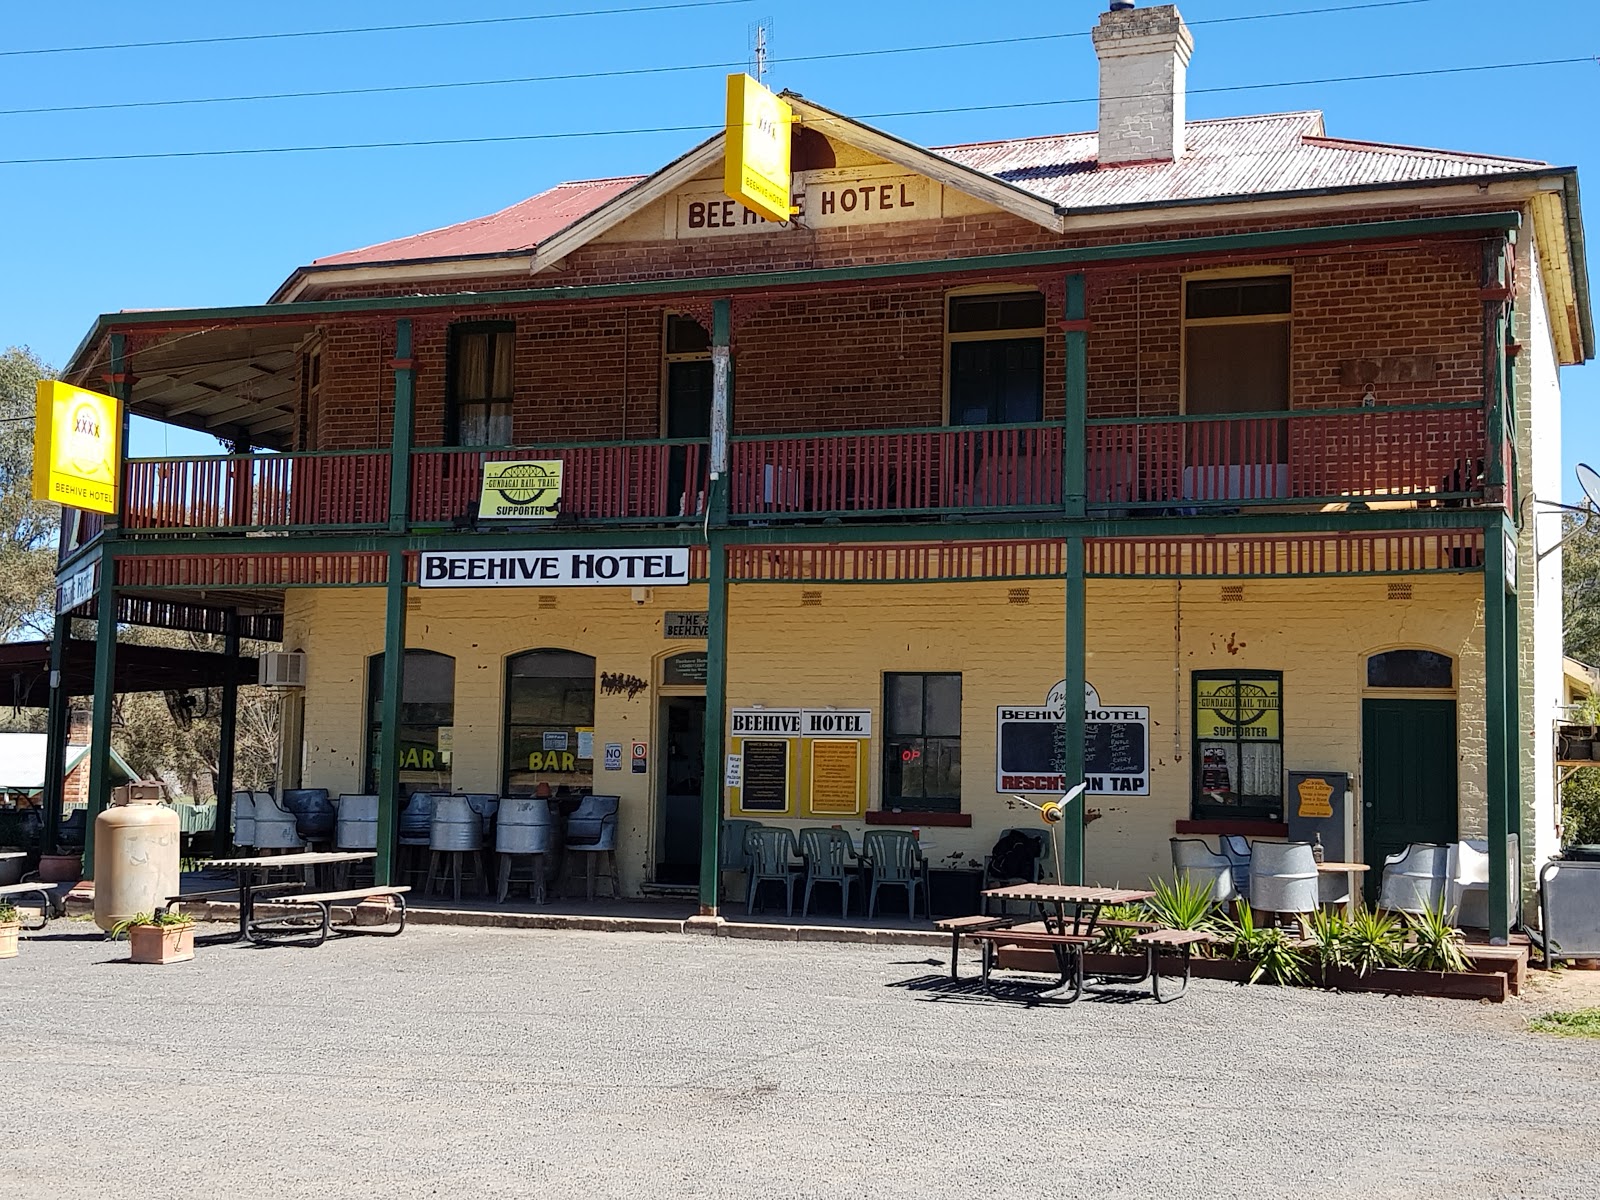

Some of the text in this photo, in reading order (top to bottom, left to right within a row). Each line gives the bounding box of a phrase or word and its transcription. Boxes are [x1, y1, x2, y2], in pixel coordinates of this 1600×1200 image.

[821, 183, 915, 215] HOTEL
[74, 418, 100, 438] XXXX
[488, 478, 557, 488] GUNDAGAI RAIL TRAIL
[55, 482, 113, 504] BEEHIVE HOTEL
[496, 505, 545, 516] SUPPORTER
[425, 554, 686, 580] BEEHIVE HOTEL
[677, 614, 700, 625] THE
[667, 625, 709, 636] BEEHIVE
[1201, 698, 1278, 708] GUNDAGAI AIL TRAIL
[1001, 710, 1146, 721] BEEHIV HOTEL
[733, 715, 863, 732] BEEHIVE HOTEL
[606, 748, 621, 759] NO
[528, 750, 575, 771] BAR
[1110, 777, 1145, 791] TAP
